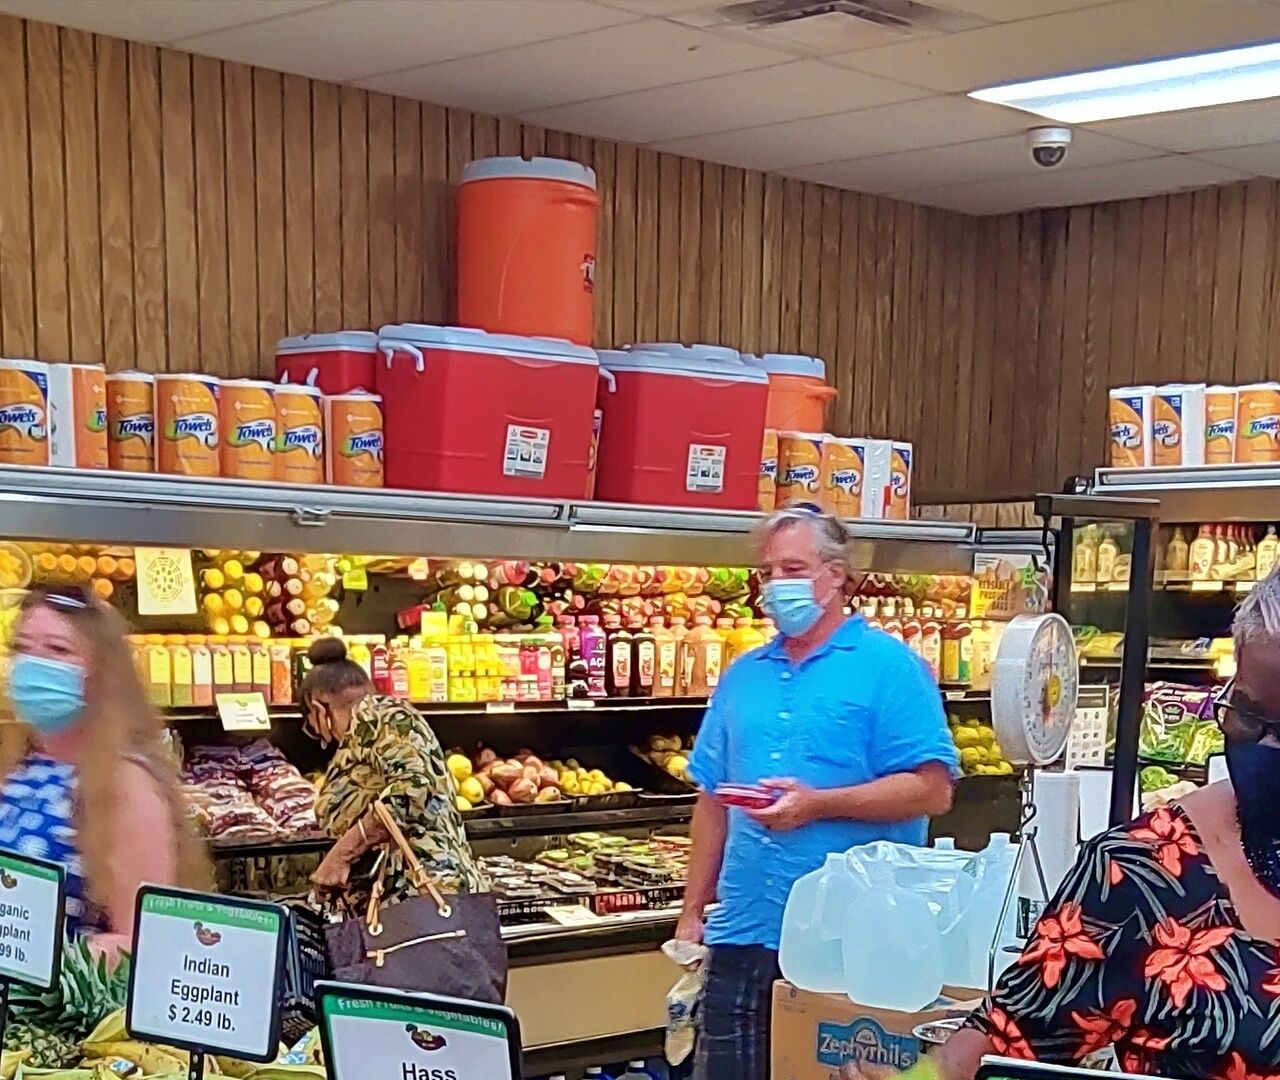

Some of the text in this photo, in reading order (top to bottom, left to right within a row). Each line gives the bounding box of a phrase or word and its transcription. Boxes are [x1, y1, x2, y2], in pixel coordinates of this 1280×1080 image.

[118, 419, 154, 435] Towe
[1208, 424, 1234, 437] Towe
[14, 948, 28, 964] lb.
[183, 954, 230, 978] Indian
[171, 979, 240, 1006] Eggplant
[168, 1003, 236, 1032] $ 2.49 lb.
[820, 1032, 913, 1068] Zephyrhils
